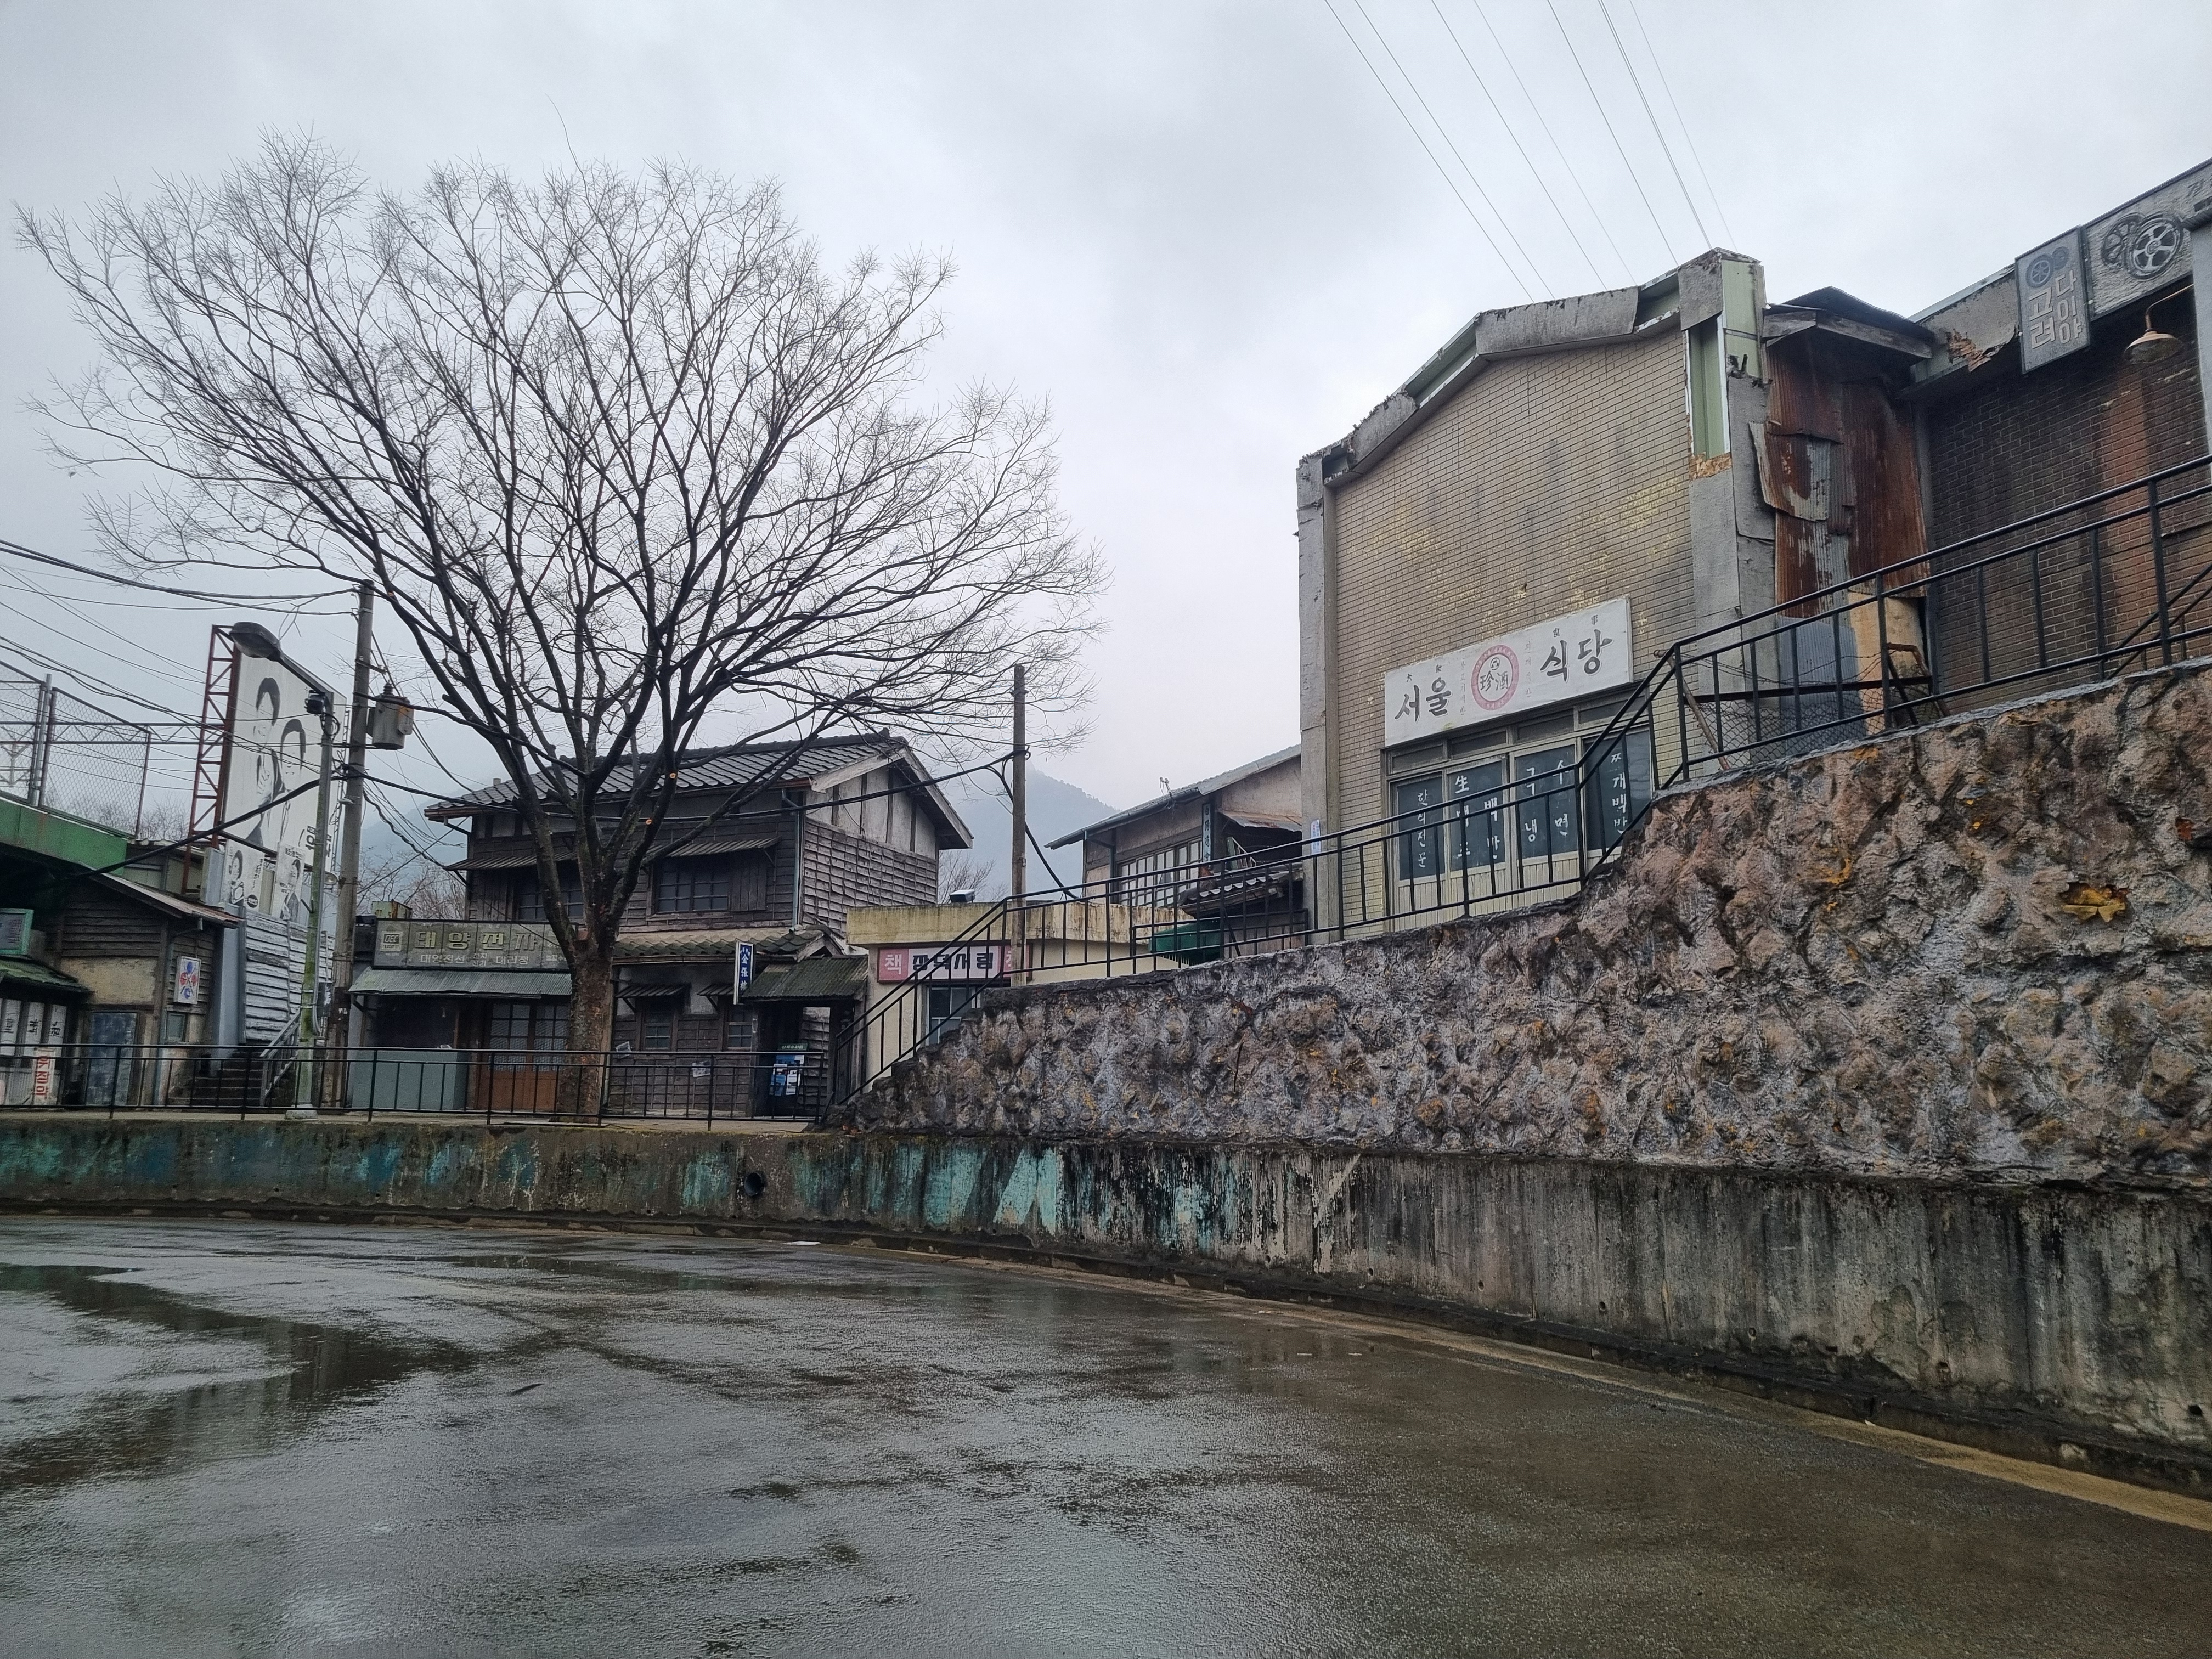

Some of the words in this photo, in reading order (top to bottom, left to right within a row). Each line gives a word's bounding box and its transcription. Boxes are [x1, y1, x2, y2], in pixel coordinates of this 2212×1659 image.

[1394, 677, 1452, 723] 서울
[1539, 629, 1613, 682] 식당
[1525, 813, 1569, 843] 냉면
[884, 953, 902, 975] 책
